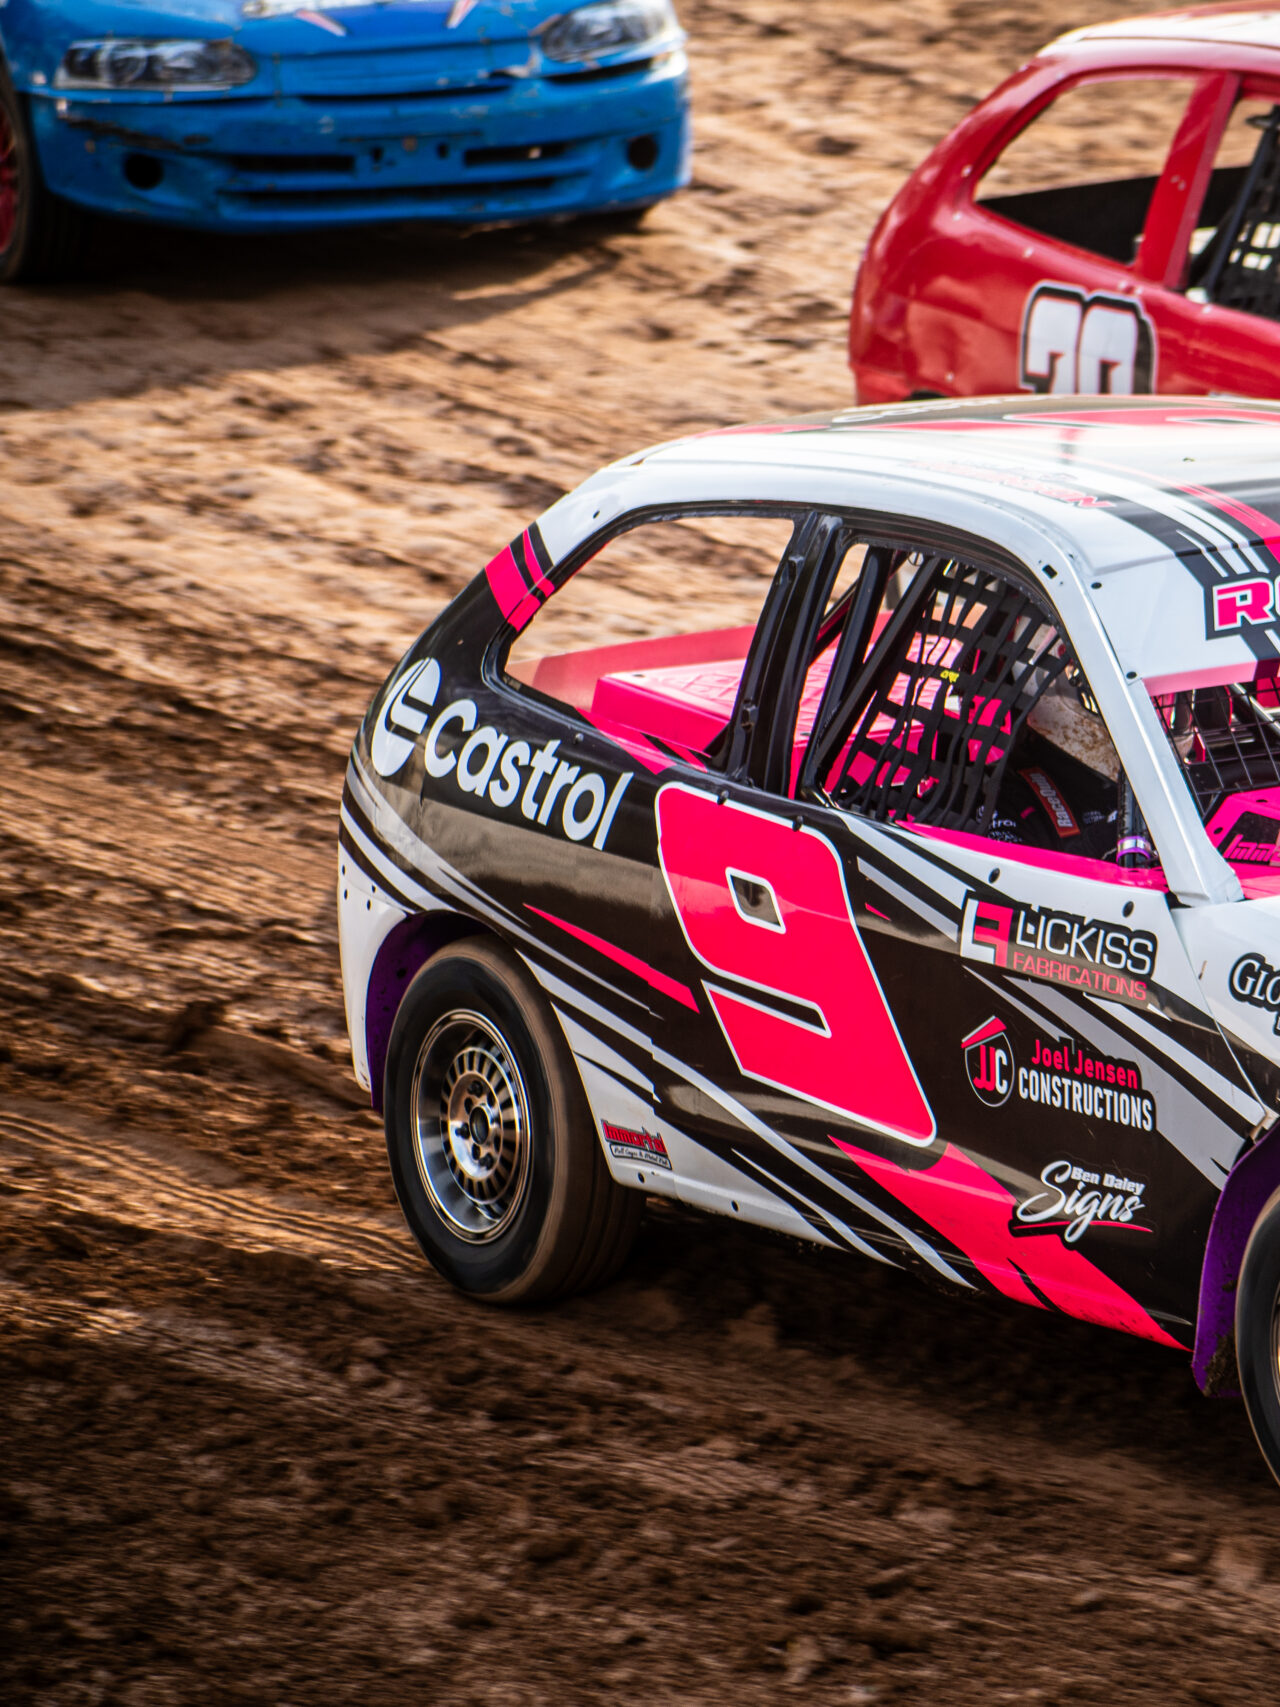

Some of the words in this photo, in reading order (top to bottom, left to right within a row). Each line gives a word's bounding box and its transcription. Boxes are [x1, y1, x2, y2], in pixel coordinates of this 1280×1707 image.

[424, 699, 635, 851] Castrol
[655, 781, 937, 1147] 9
[1016, 910, 1154, 975] LICKISS
[1013, 951, 1148, 1000] FABRICATIONS
[1031, 1039, 1070, 1072] Joel
[1074, 1048, 1138, 1090] Jensen
[1018, 1066, 1153, 1132] CONSTRUCTIONS
[602, 1121, 668, 1154] Immortal
[1016, 1160, 1146, 1243] Signs
[1070, 1166, 1101, 1185] Ben
[1102, 1172, 1146, 1196] Daley
